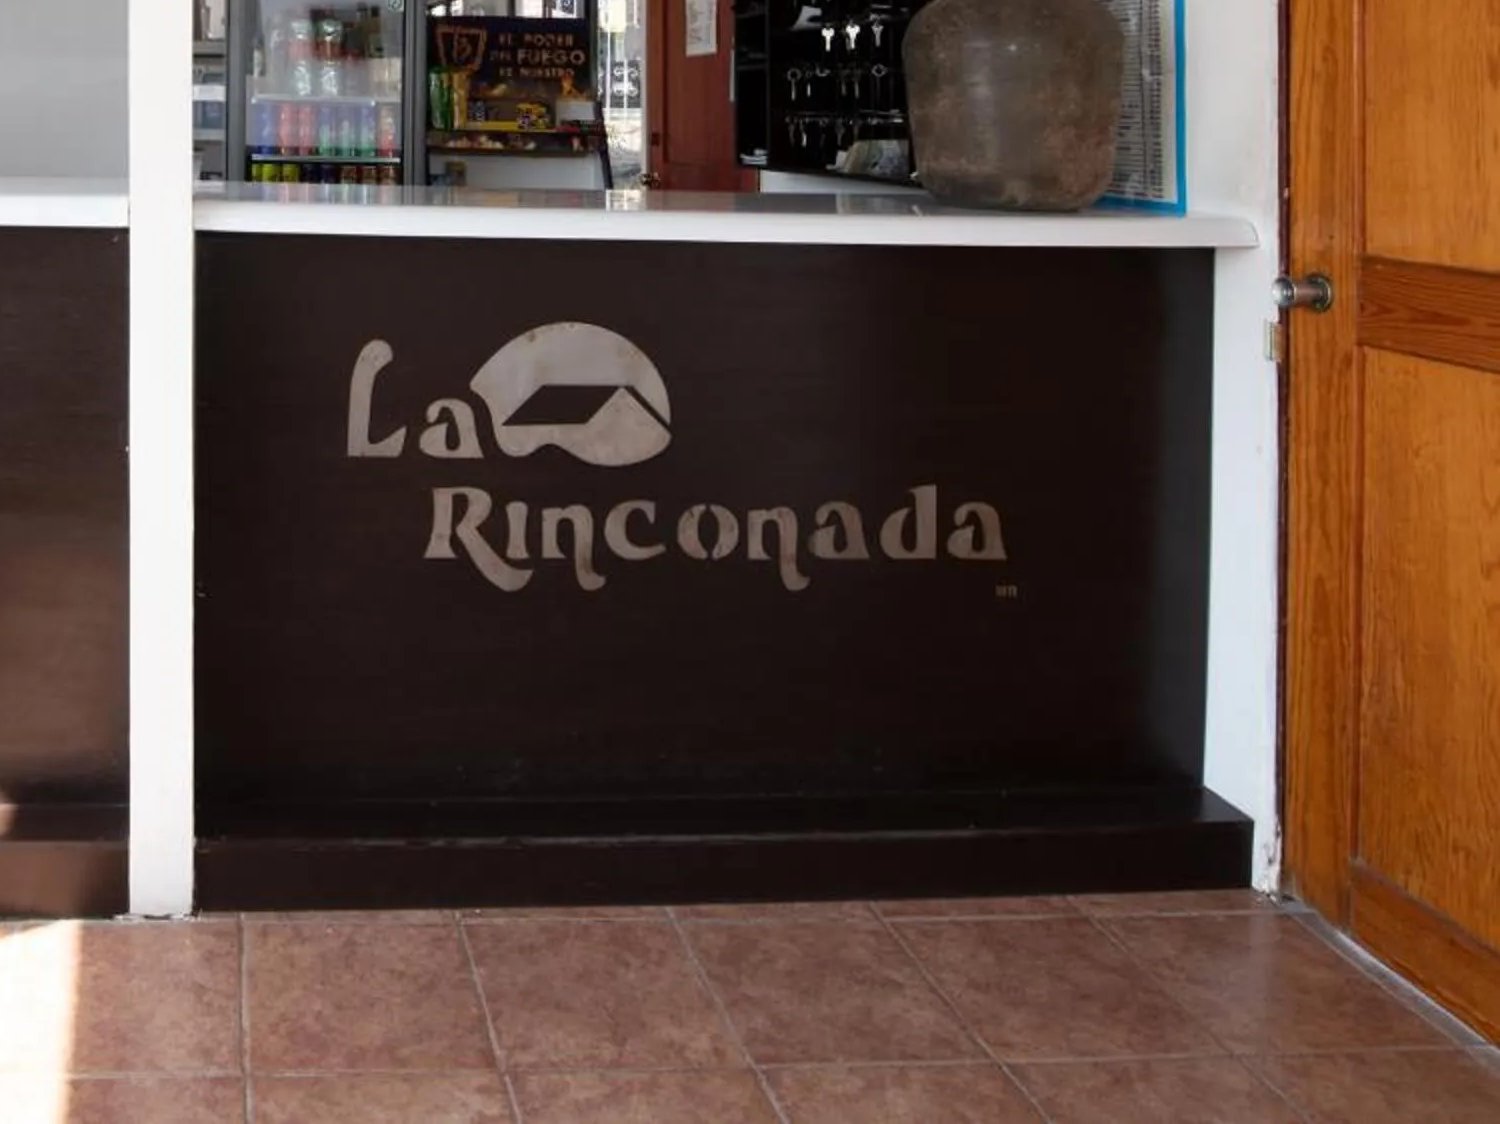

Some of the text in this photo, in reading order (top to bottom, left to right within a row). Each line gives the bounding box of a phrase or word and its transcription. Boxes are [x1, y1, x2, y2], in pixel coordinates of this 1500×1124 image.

[517, 48, 586, 65] FUEGO
[347, 338, 485, 459] La
[422, 484, 1008, 592] Rinconada
